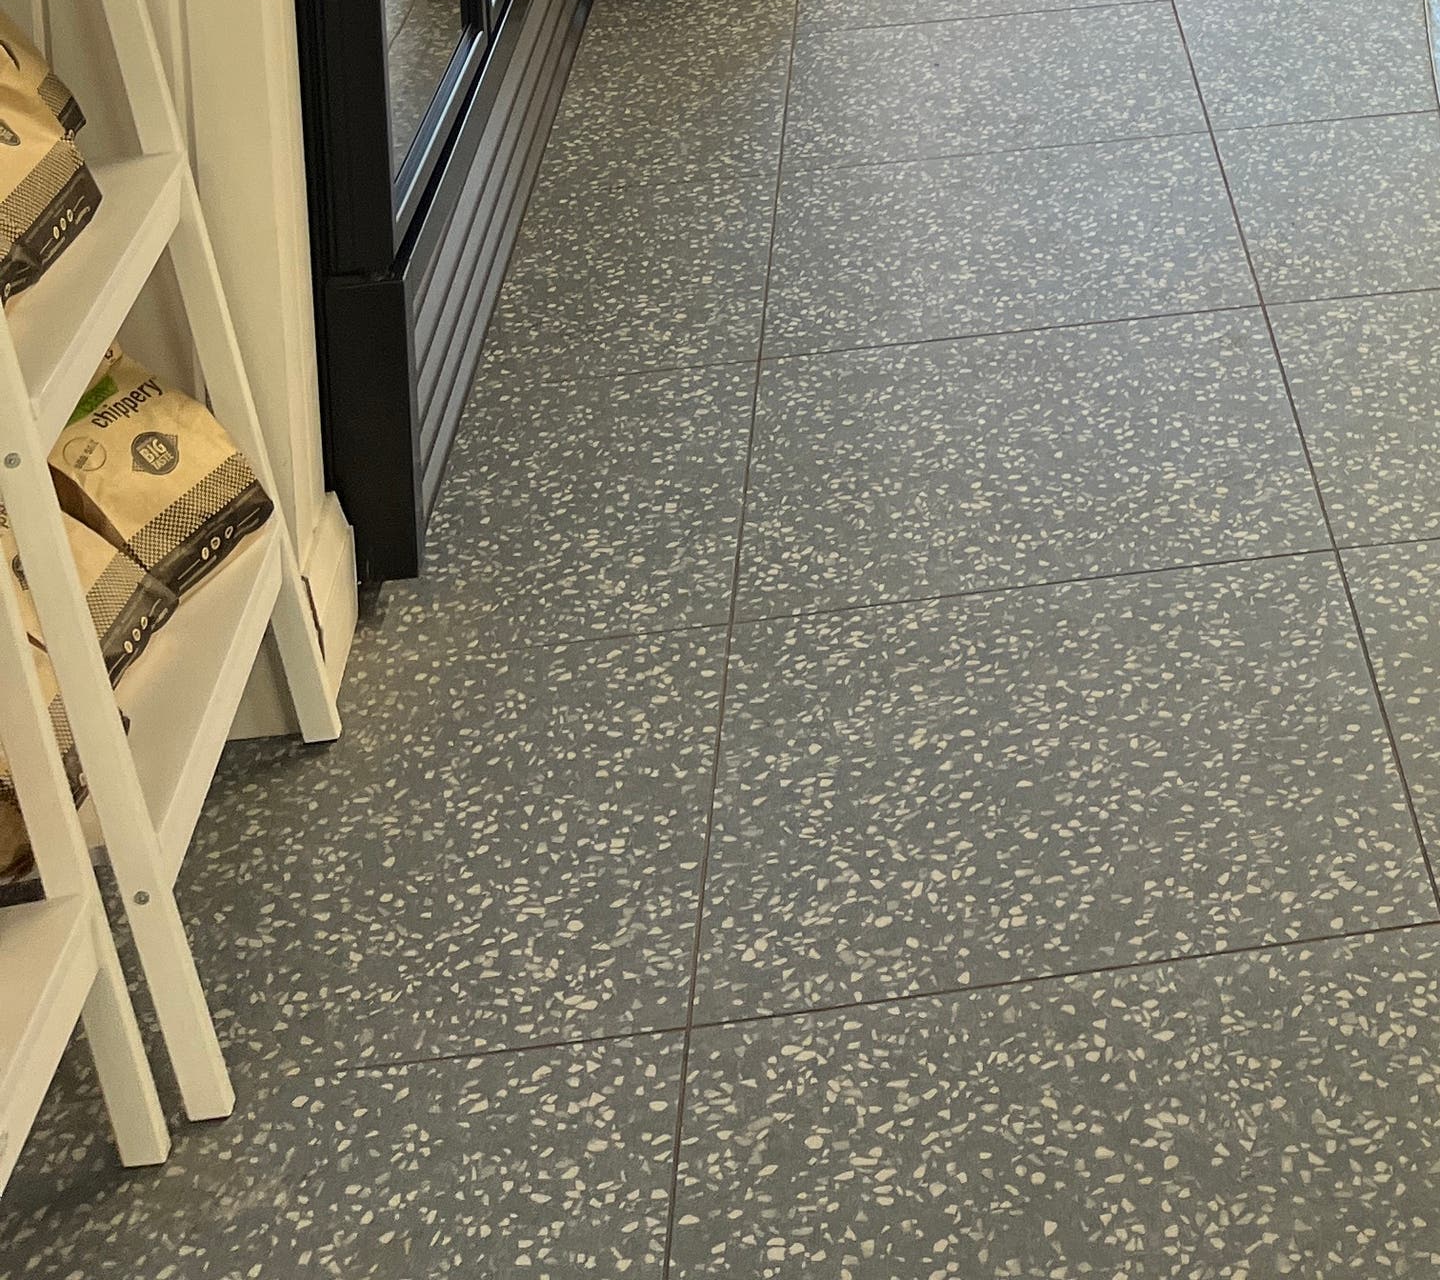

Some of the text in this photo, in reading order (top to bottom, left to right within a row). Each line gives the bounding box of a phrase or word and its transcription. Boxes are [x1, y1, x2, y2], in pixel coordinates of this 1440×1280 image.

[91, 377, 164, 430] chippery
[138, 437, 168, 465] BIG
[150, 452, 175, 471] TASTE
